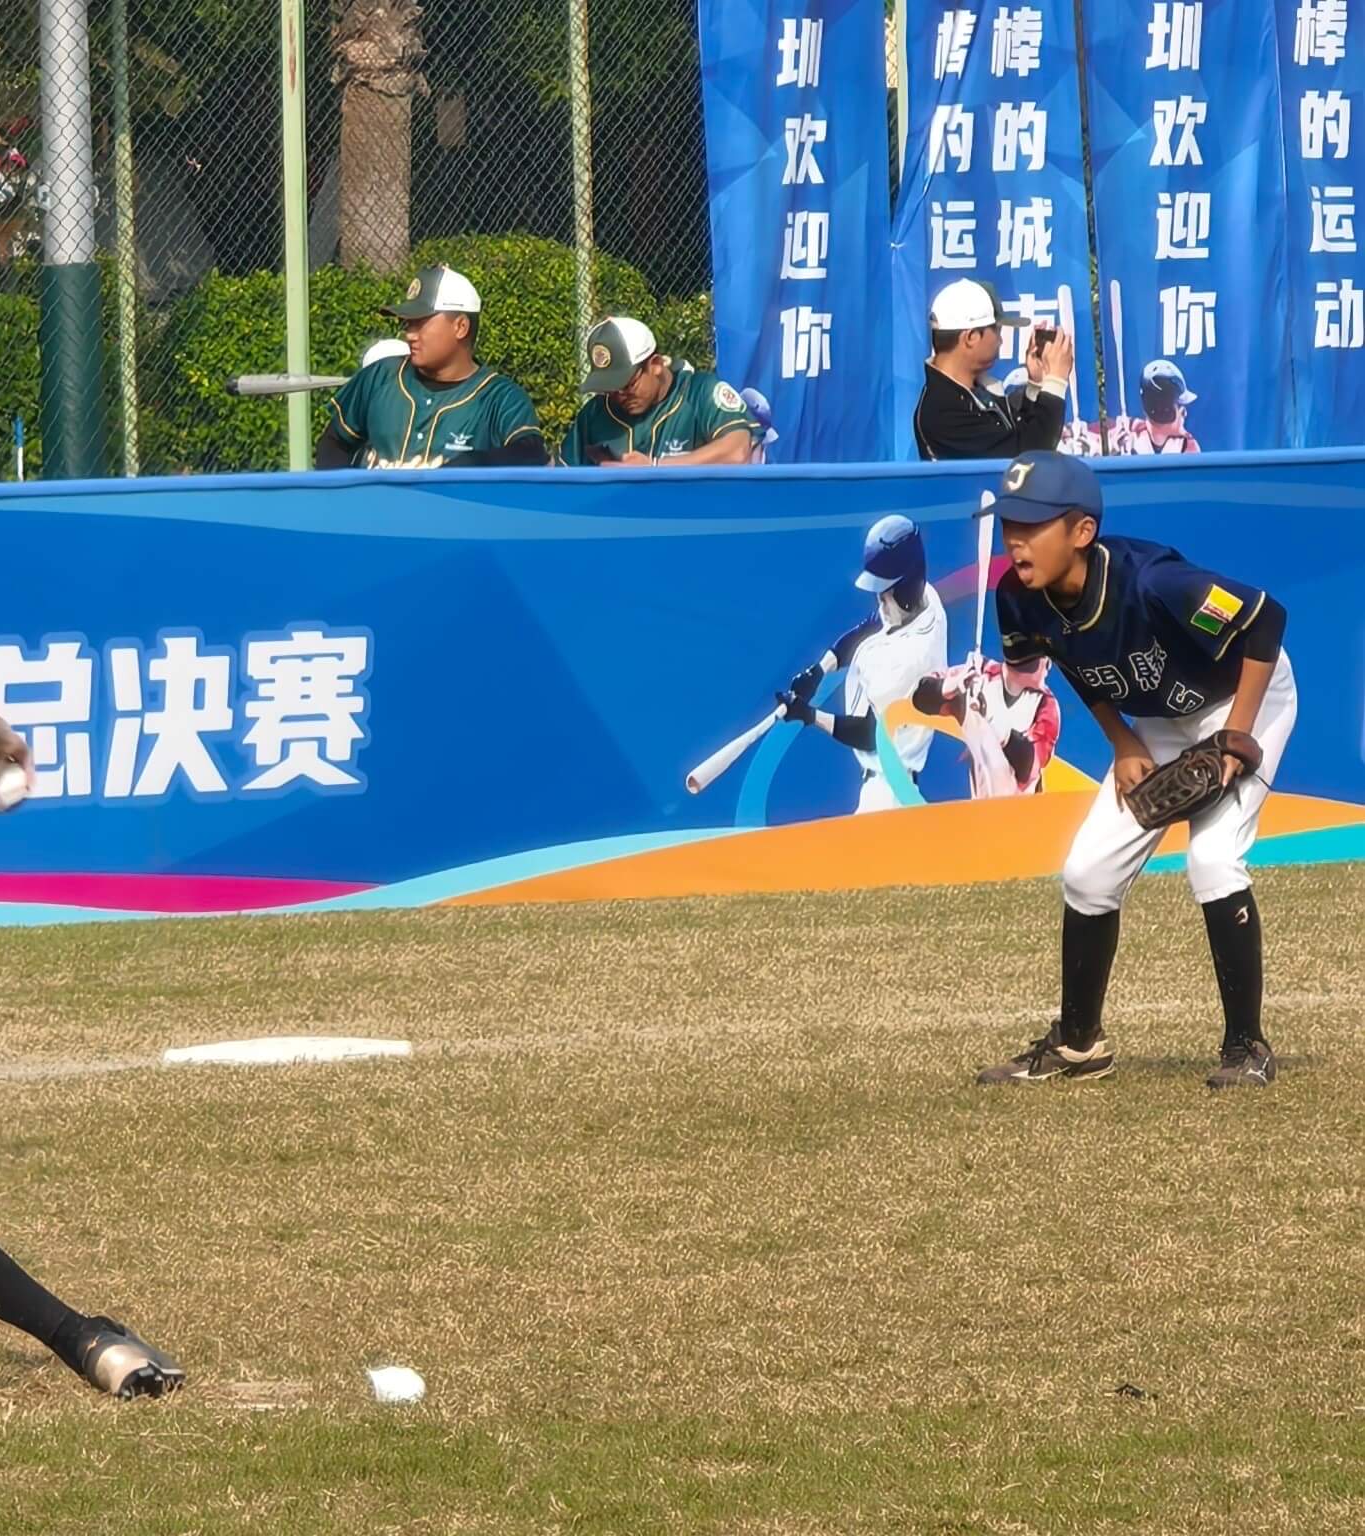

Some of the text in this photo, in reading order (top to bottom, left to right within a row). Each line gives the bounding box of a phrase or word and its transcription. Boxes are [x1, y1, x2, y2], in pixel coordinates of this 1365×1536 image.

[777, 18, 832, 379] 圳欢迎你
[928, 10, 977, 270] 棒的运
[1145, 2, 1217, 356] 圳欢迎你
[1293, 0, 1365, 349] 棒的运动
